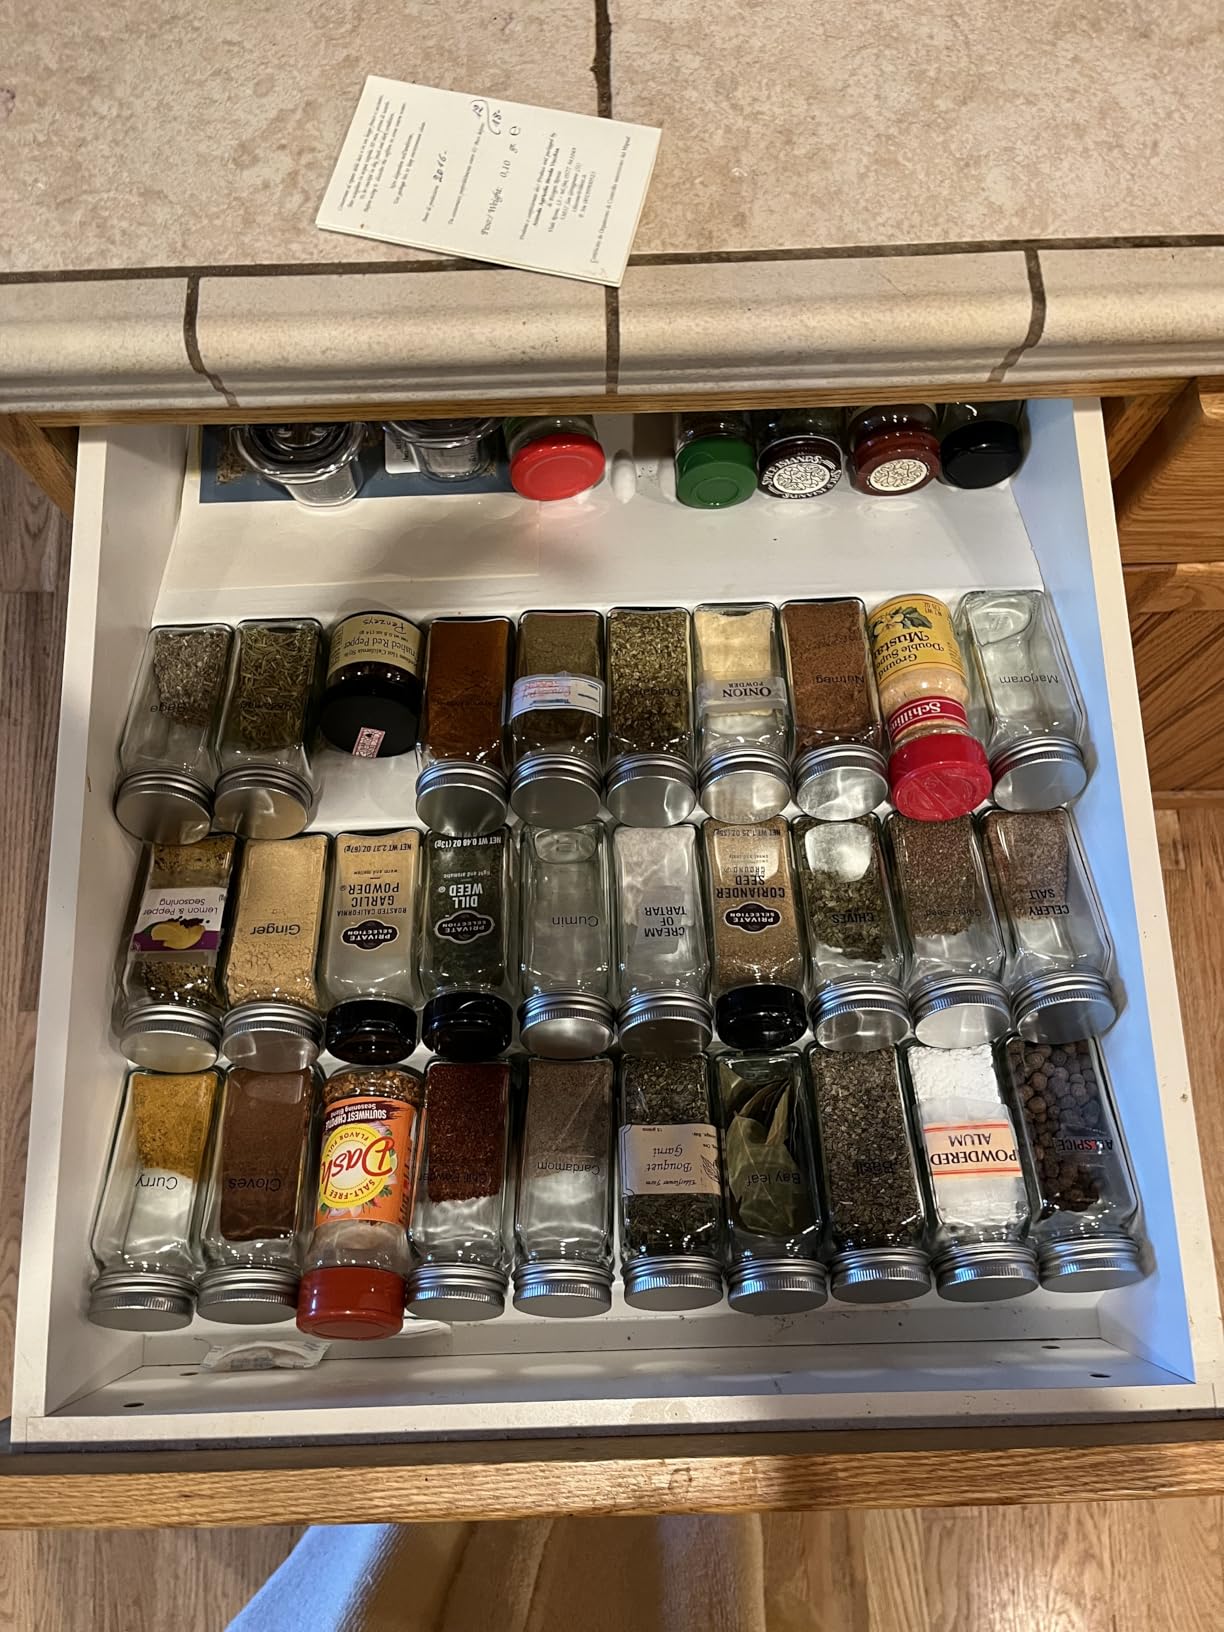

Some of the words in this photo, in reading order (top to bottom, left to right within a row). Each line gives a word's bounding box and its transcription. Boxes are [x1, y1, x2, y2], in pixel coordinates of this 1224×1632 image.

[762, 463, 779, 486] SPICE
[774, 456, 821, 472] ISLANDS
[362, 619, 406, 635] Penzeys
[344, 636, 370, 650] Pepper
[372, 637, 389, 649] Red
[900, 643, 944, 652] Double
[878, 653, 917, 680] Ground
[727, 681, 764, 689] POWDER
[815, 673, 865, 685] Nutmeg
[999, 673, 1059, 686] Marjoram
[722, 686, 772, 698] ONION
[731, 829, 740, 838] OZ
[741, 828, 757, 838] 1.25
[757, 828, 766, 837] WT
[767, 828, 781, 837] NET
[434, 838, 452, 849] (13g)
[452, 839, 462, 848] OZ
[462, 838, 477, 848] 0.48
[478, 836, 488, 845] WT
[488, 836, 502, 844] NET
[373, 844, 387, 853] 2.37
[388, 844, 399, 852] WT
[400, 843, 412, 852] NET
[733, 866, 766, 874] GROUND
[734, 874, 765, 886] SEED
[348, 882, 400, 894] POWDER
[448, 883, 483, 896] WEED
[715, 886, 786, 900] CORIANDER
[1027, 888, 1055, 900] SALT
[159, 897, 206, 908] Seasoning
[351, 895, 395, 908] GARLIC
[452, 895, 479, 908] DILL
[142, 906, 176, 918] Pepper
[178, 907, 184, 916] &
[186, 906, 218, 917] Lemon
[336, 908, 376, 917] CALIFORNIA
[377, 907, 407, 915] ROASTED
[643, 905, 687, 916] TARTAR
[1028, 904, 1070, 917] CELERY
[442, 918, 487, 928] SELECTION
[551, 915, 600, 928] Cumin
[659, 916, 675, 927] OF
[831, 911, 875, 924] CHIVES
[249, 923, 301, 937] Ginger
[346, 928, 393, 936] SELECTION
[444, 924, 486, 932] PRIVATE
[643, 926, 686, 938] CREAM
[348, 933, 391, 942] PRIVATE
[330, 1108, 344, 1118] Blend
[344, 1103, 377, 1113] Seasoning
[347, 1109, 387, 1122] SOUTHWEST
[324, 1113, 347, 1131] CHIPOTLE
[339, 1131, 370, 1141] FLAVOR
[947, 1133, 992, 1147] ALUM
[652, 1144, 683, 1157] Garni
[930, 1149, 1017, 1166] POWDERED
[320, 1136, 395, 1195] Dash
[536, 1161, 600, 1176] Cardamom
[646, 1160, 692, 1173] Bouquet
[854, 1161, 894, 1175] Basil
[135, 1174, 179, 1192] Curry
[744, 1174, 772, 1186] leaf
[774, 1172, 801, 1184] Bay
[227, 1176, 282, 1193] Cloves
[328, 1179, 376, 1200] SALT-FREE
